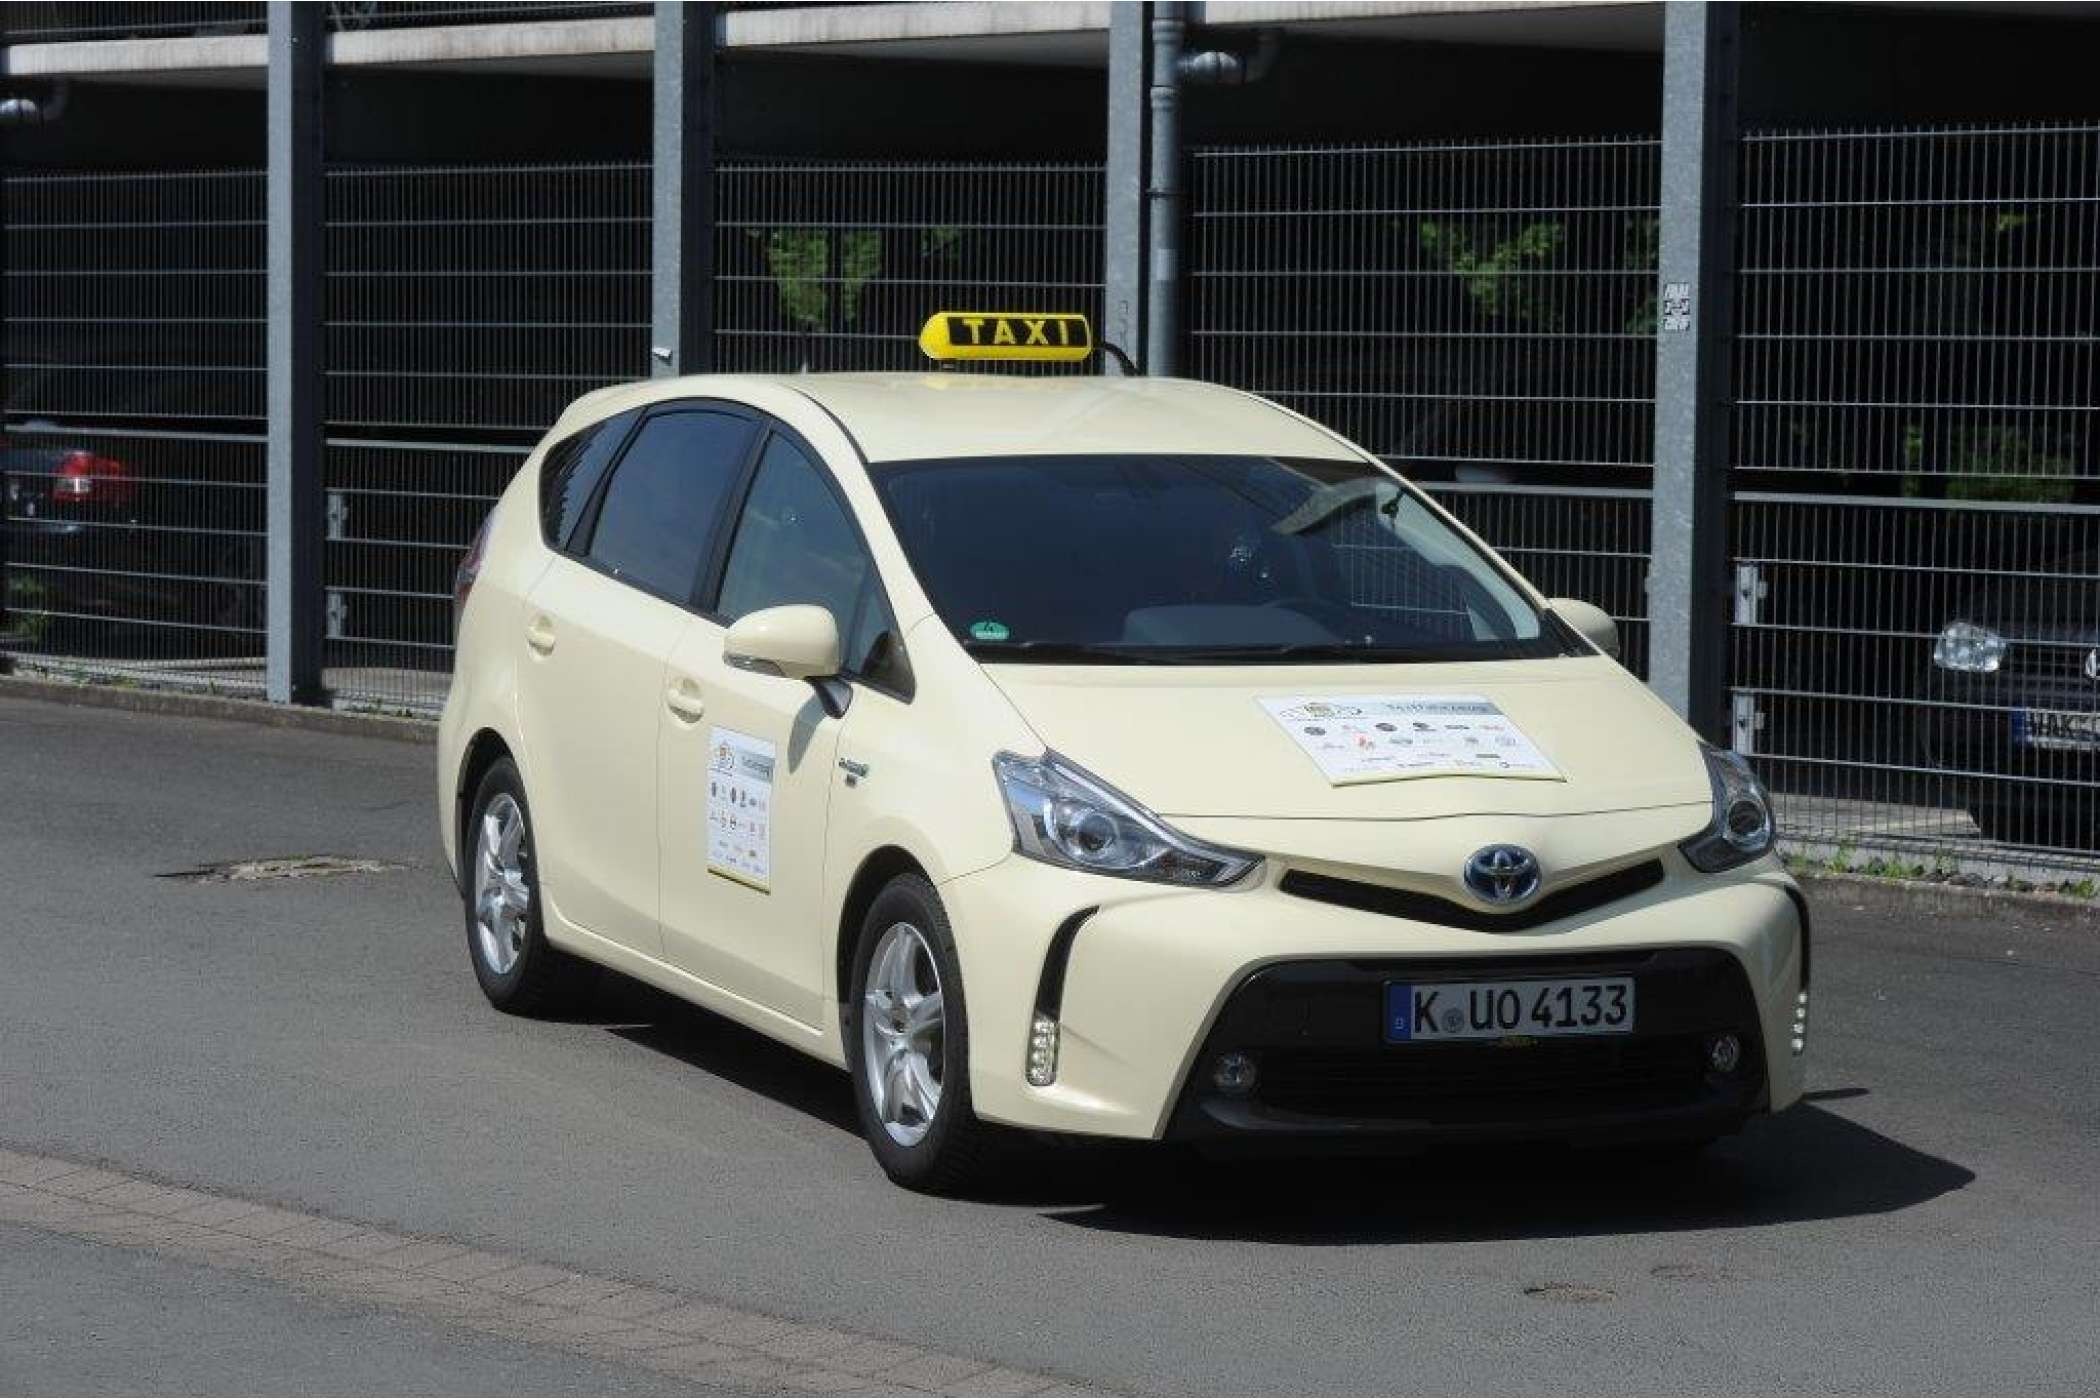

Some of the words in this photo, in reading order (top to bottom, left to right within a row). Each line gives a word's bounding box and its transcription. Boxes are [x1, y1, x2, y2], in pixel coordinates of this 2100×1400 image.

[962, 318, 1070, 345] TAXI
[1414, 990, 1440, 1033] K
[1469, 988, 1521, 1031] UO
[1531, 985, 1628, 1028] 4133
